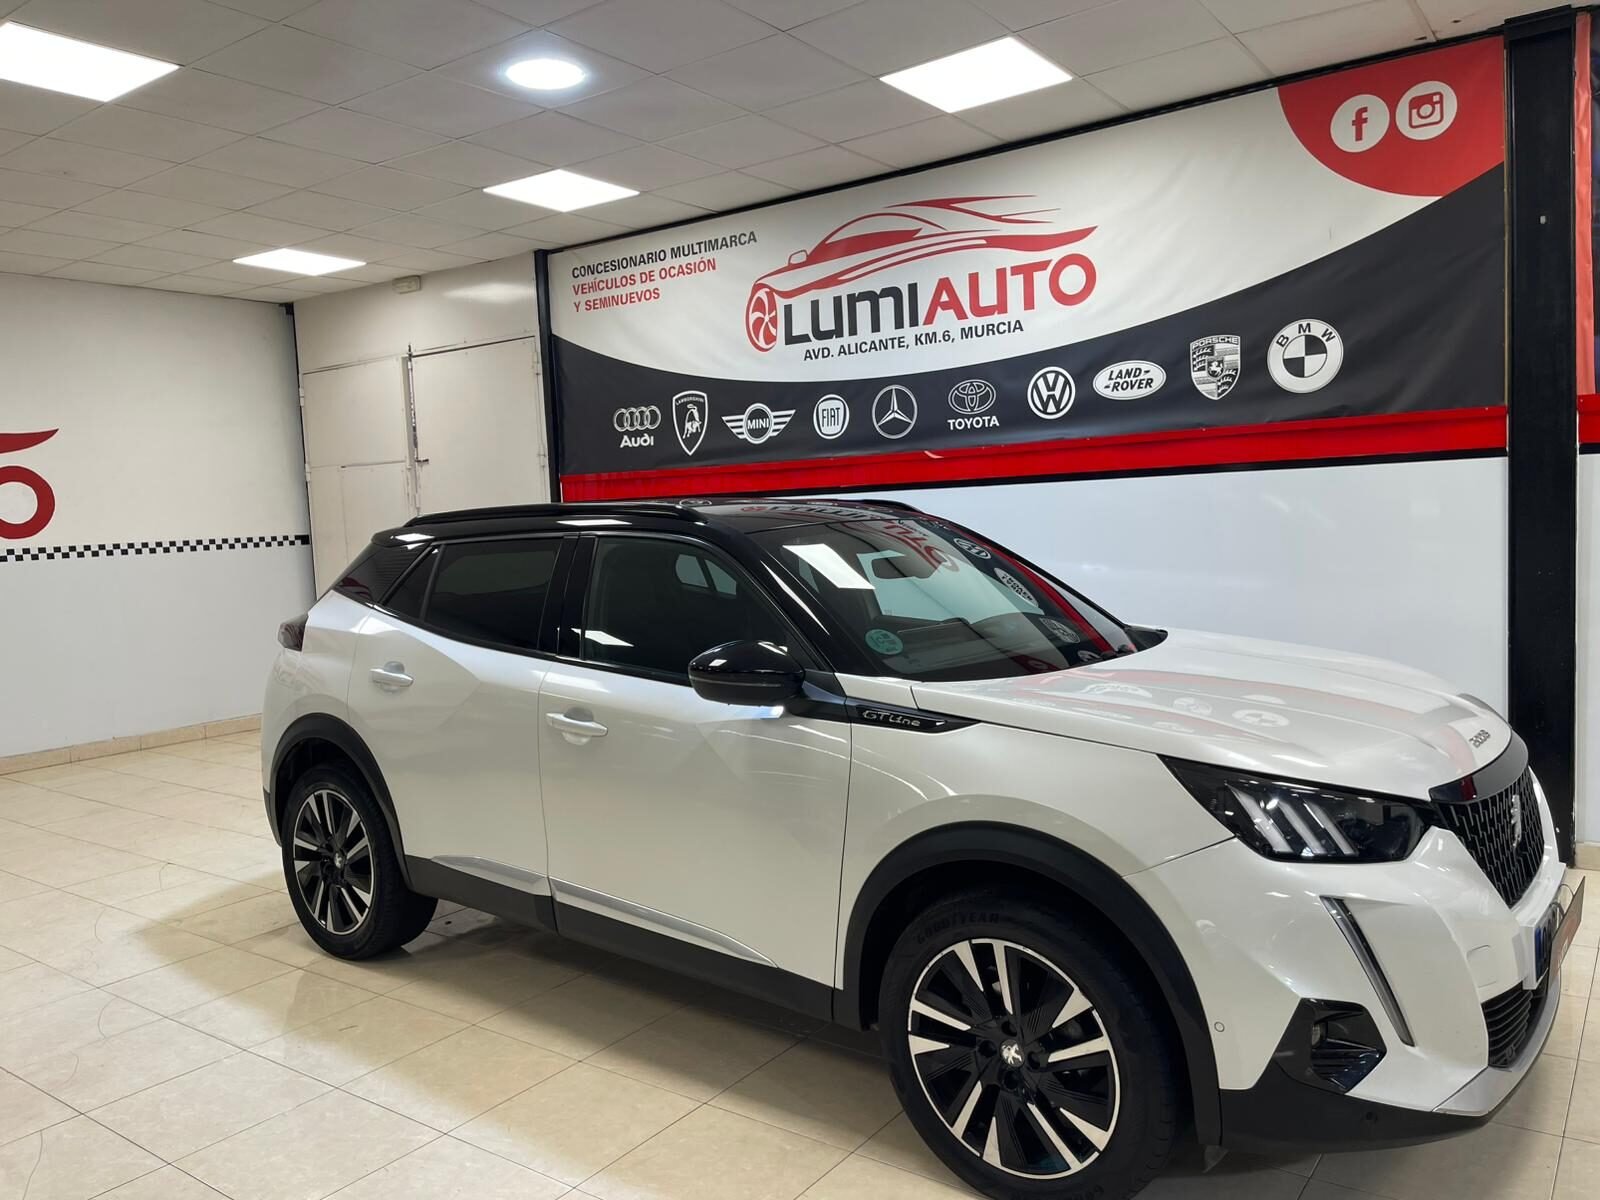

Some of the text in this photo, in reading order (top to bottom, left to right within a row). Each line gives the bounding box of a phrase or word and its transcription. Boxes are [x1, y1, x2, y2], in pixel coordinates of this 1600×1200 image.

[572, 231, 757, 279] CONCESIONARIO MULTIMARCA
[573, 257, 716, 296] VEHÍCULOS DE OCASIÓN
[574, 287, 660, 313] Y SEMINUEVOS
[803, 319, 1024, 361] AVD. ALICANTE, KM.6, MURCIA
[1192, 336, 1239, 350] PORSCHE
[747, 418, 770, 430] MINI
[821, 407, 841, 429] FIAT
[947, 415, 1000, 431] TOYOTA
